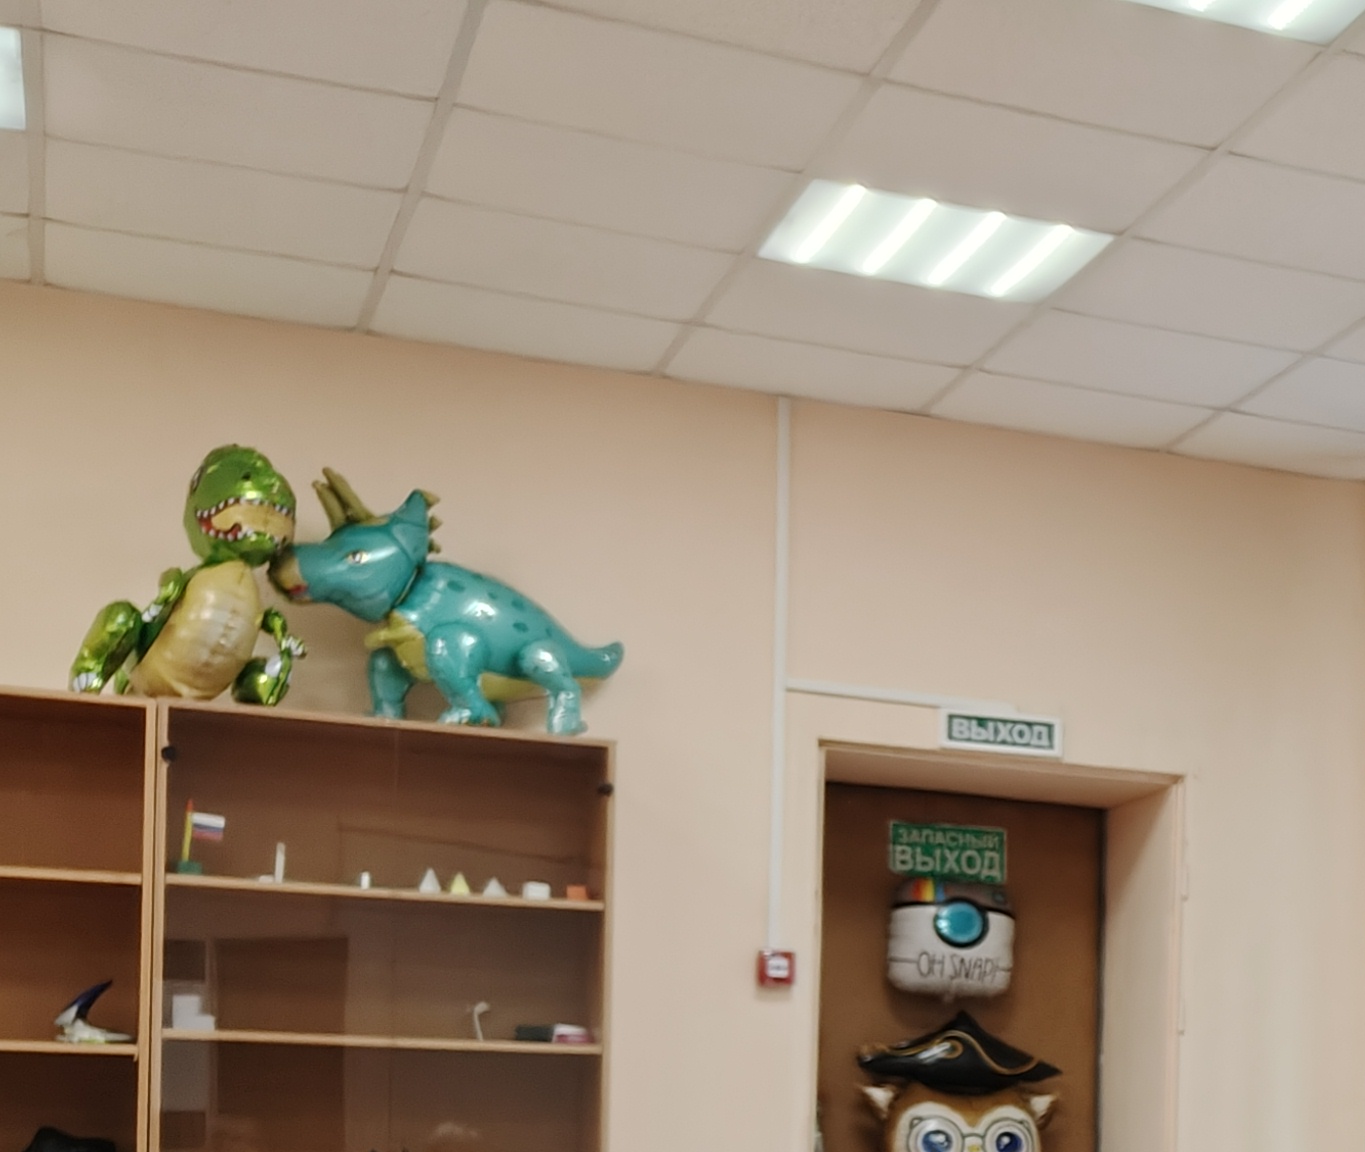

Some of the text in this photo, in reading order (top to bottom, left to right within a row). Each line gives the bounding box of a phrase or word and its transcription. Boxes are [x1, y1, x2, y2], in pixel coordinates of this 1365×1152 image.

[951, 718, 1052, 748] ВЫХОД
[898, 828, 1000, 850] ЗАПАСНЫЙ
[894, 845, 1002, 881] ВЫХОД
[916, 950, 945, 978] OH
